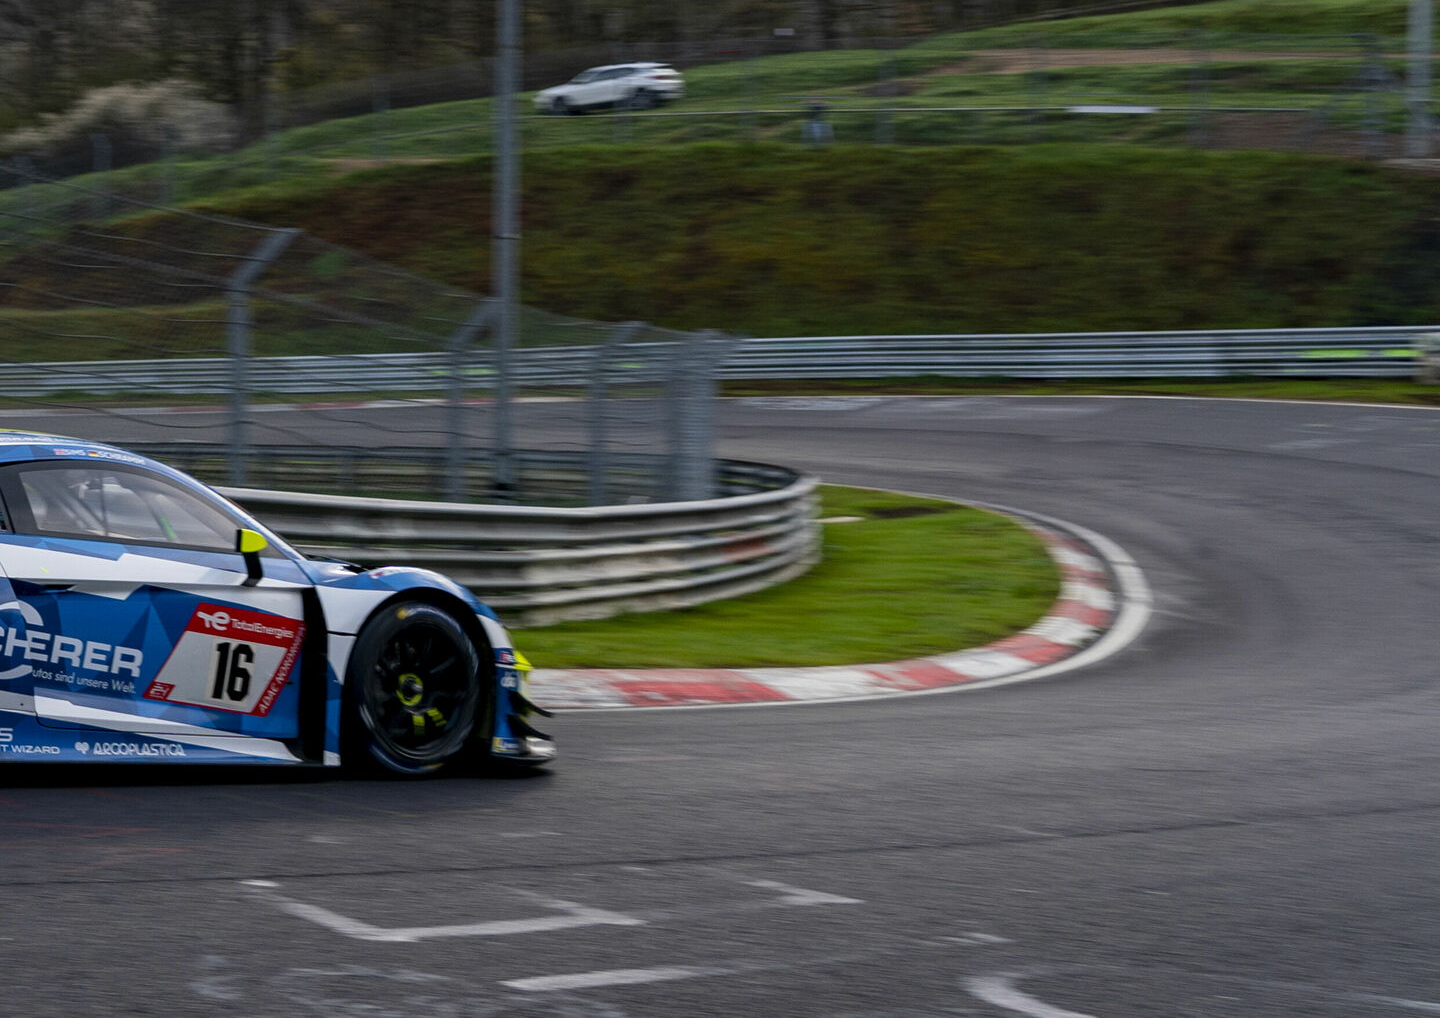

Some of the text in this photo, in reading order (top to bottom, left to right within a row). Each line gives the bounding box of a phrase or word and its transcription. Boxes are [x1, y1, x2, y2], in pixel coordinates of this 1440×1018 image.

[231, 618, 295, 639] TotalEnergies
[212, 641, 254, 702] 16
[54, 672, 75, 684] sind
[76, 678, 109, 690] unsere
[10, 745, 60, 754] WIZARD
[93, 742, 187, 757] ARCOPLASTICA
